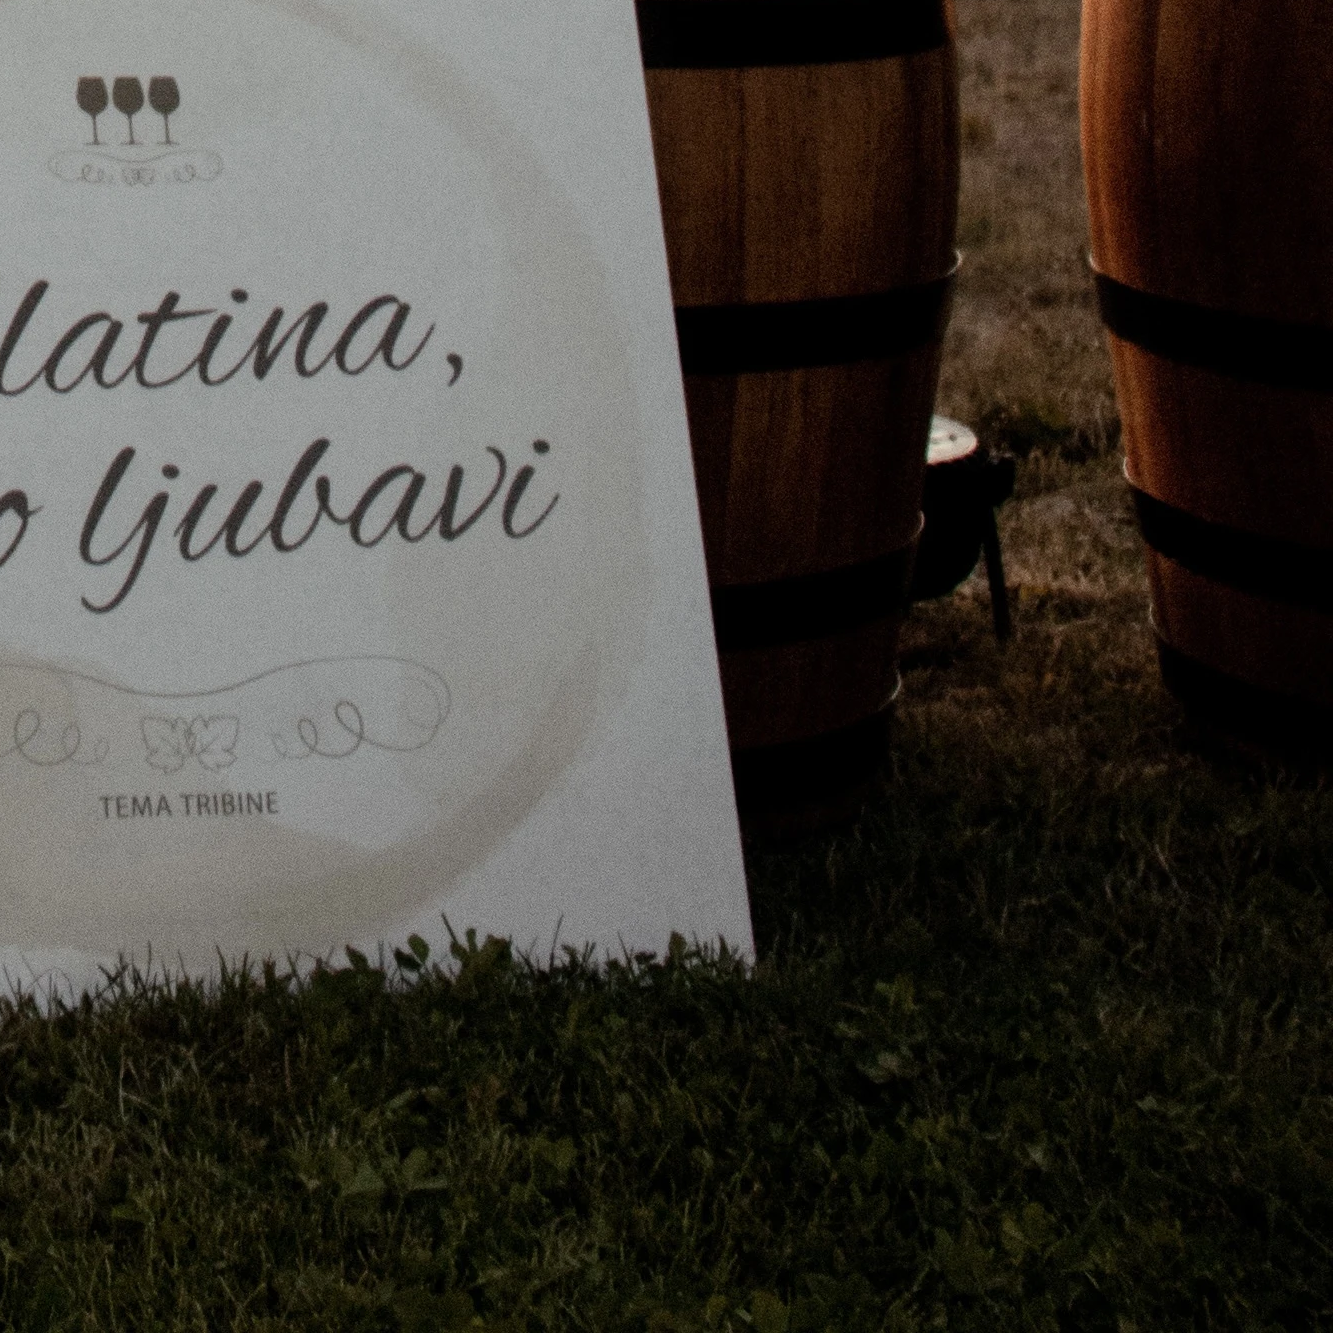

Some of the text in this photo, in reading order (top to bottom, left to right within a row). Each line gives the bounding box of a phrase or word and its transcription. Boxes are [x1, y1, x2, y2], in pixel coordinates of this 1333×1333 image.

[78, 437, 562, 615] ljubavi
[98, 790, 281, 820] TEMA TRIBINE
